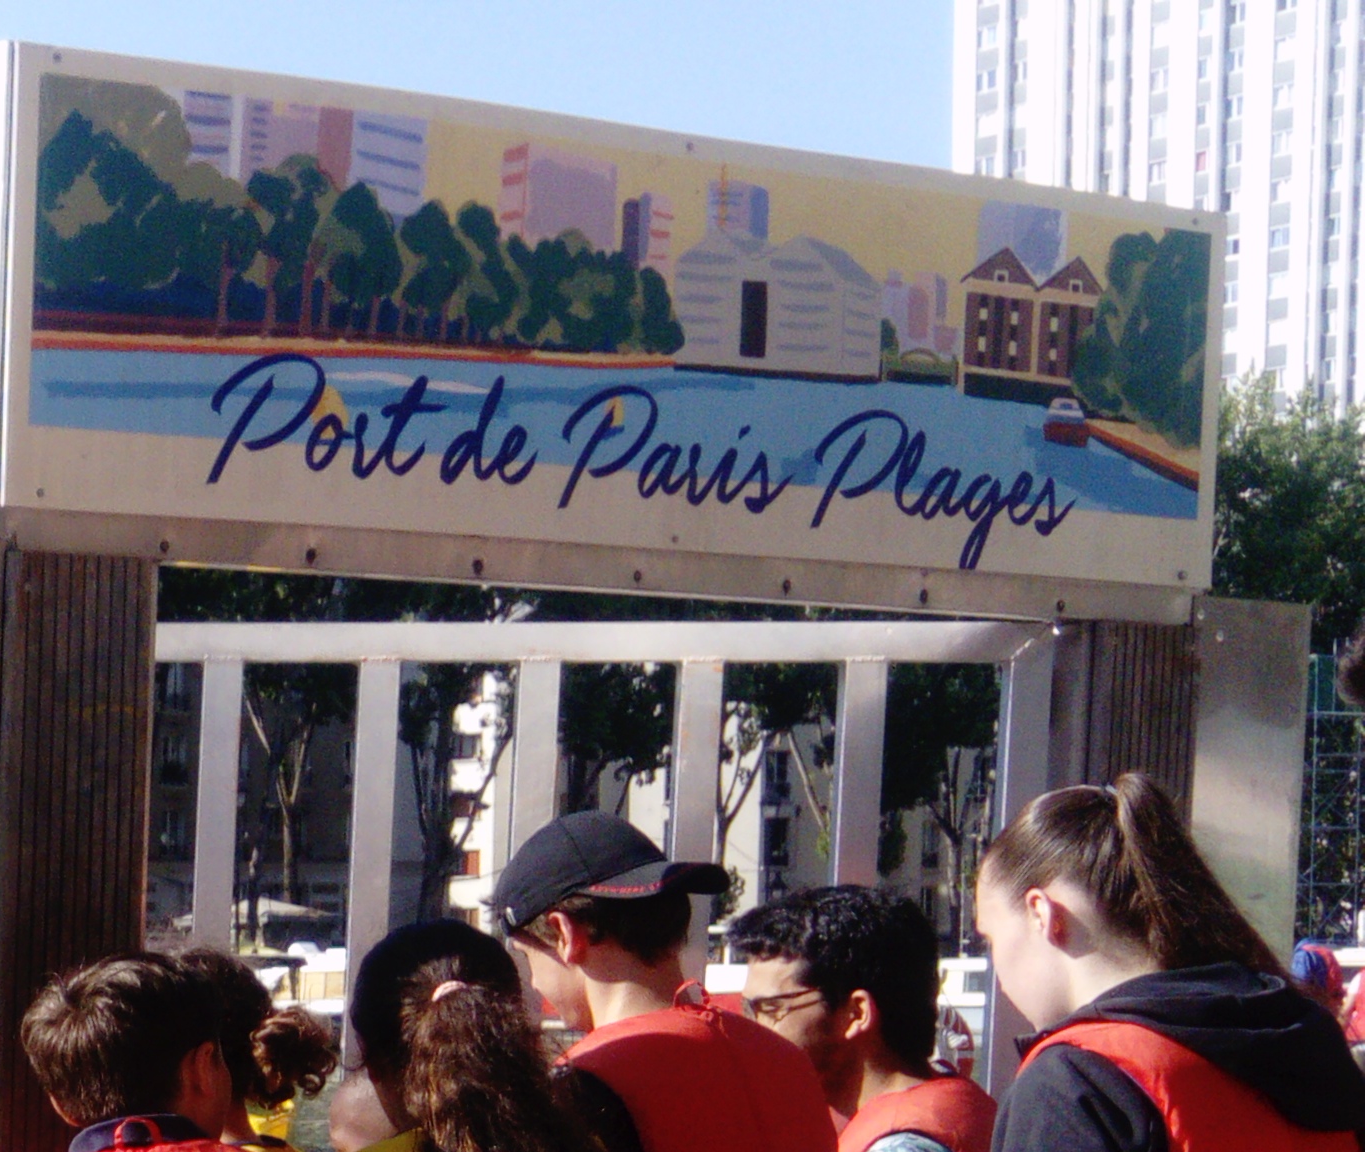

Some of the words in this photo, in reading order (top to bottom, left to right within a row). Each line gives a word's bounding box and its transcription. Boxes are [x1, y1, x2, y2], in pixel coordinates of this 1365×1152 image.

[208, 352, 447, 483] Port
[441, 376, 539, 485] de
[559, 383, 795, 514] Paris
[811, 409, 1076, 571] Plages
